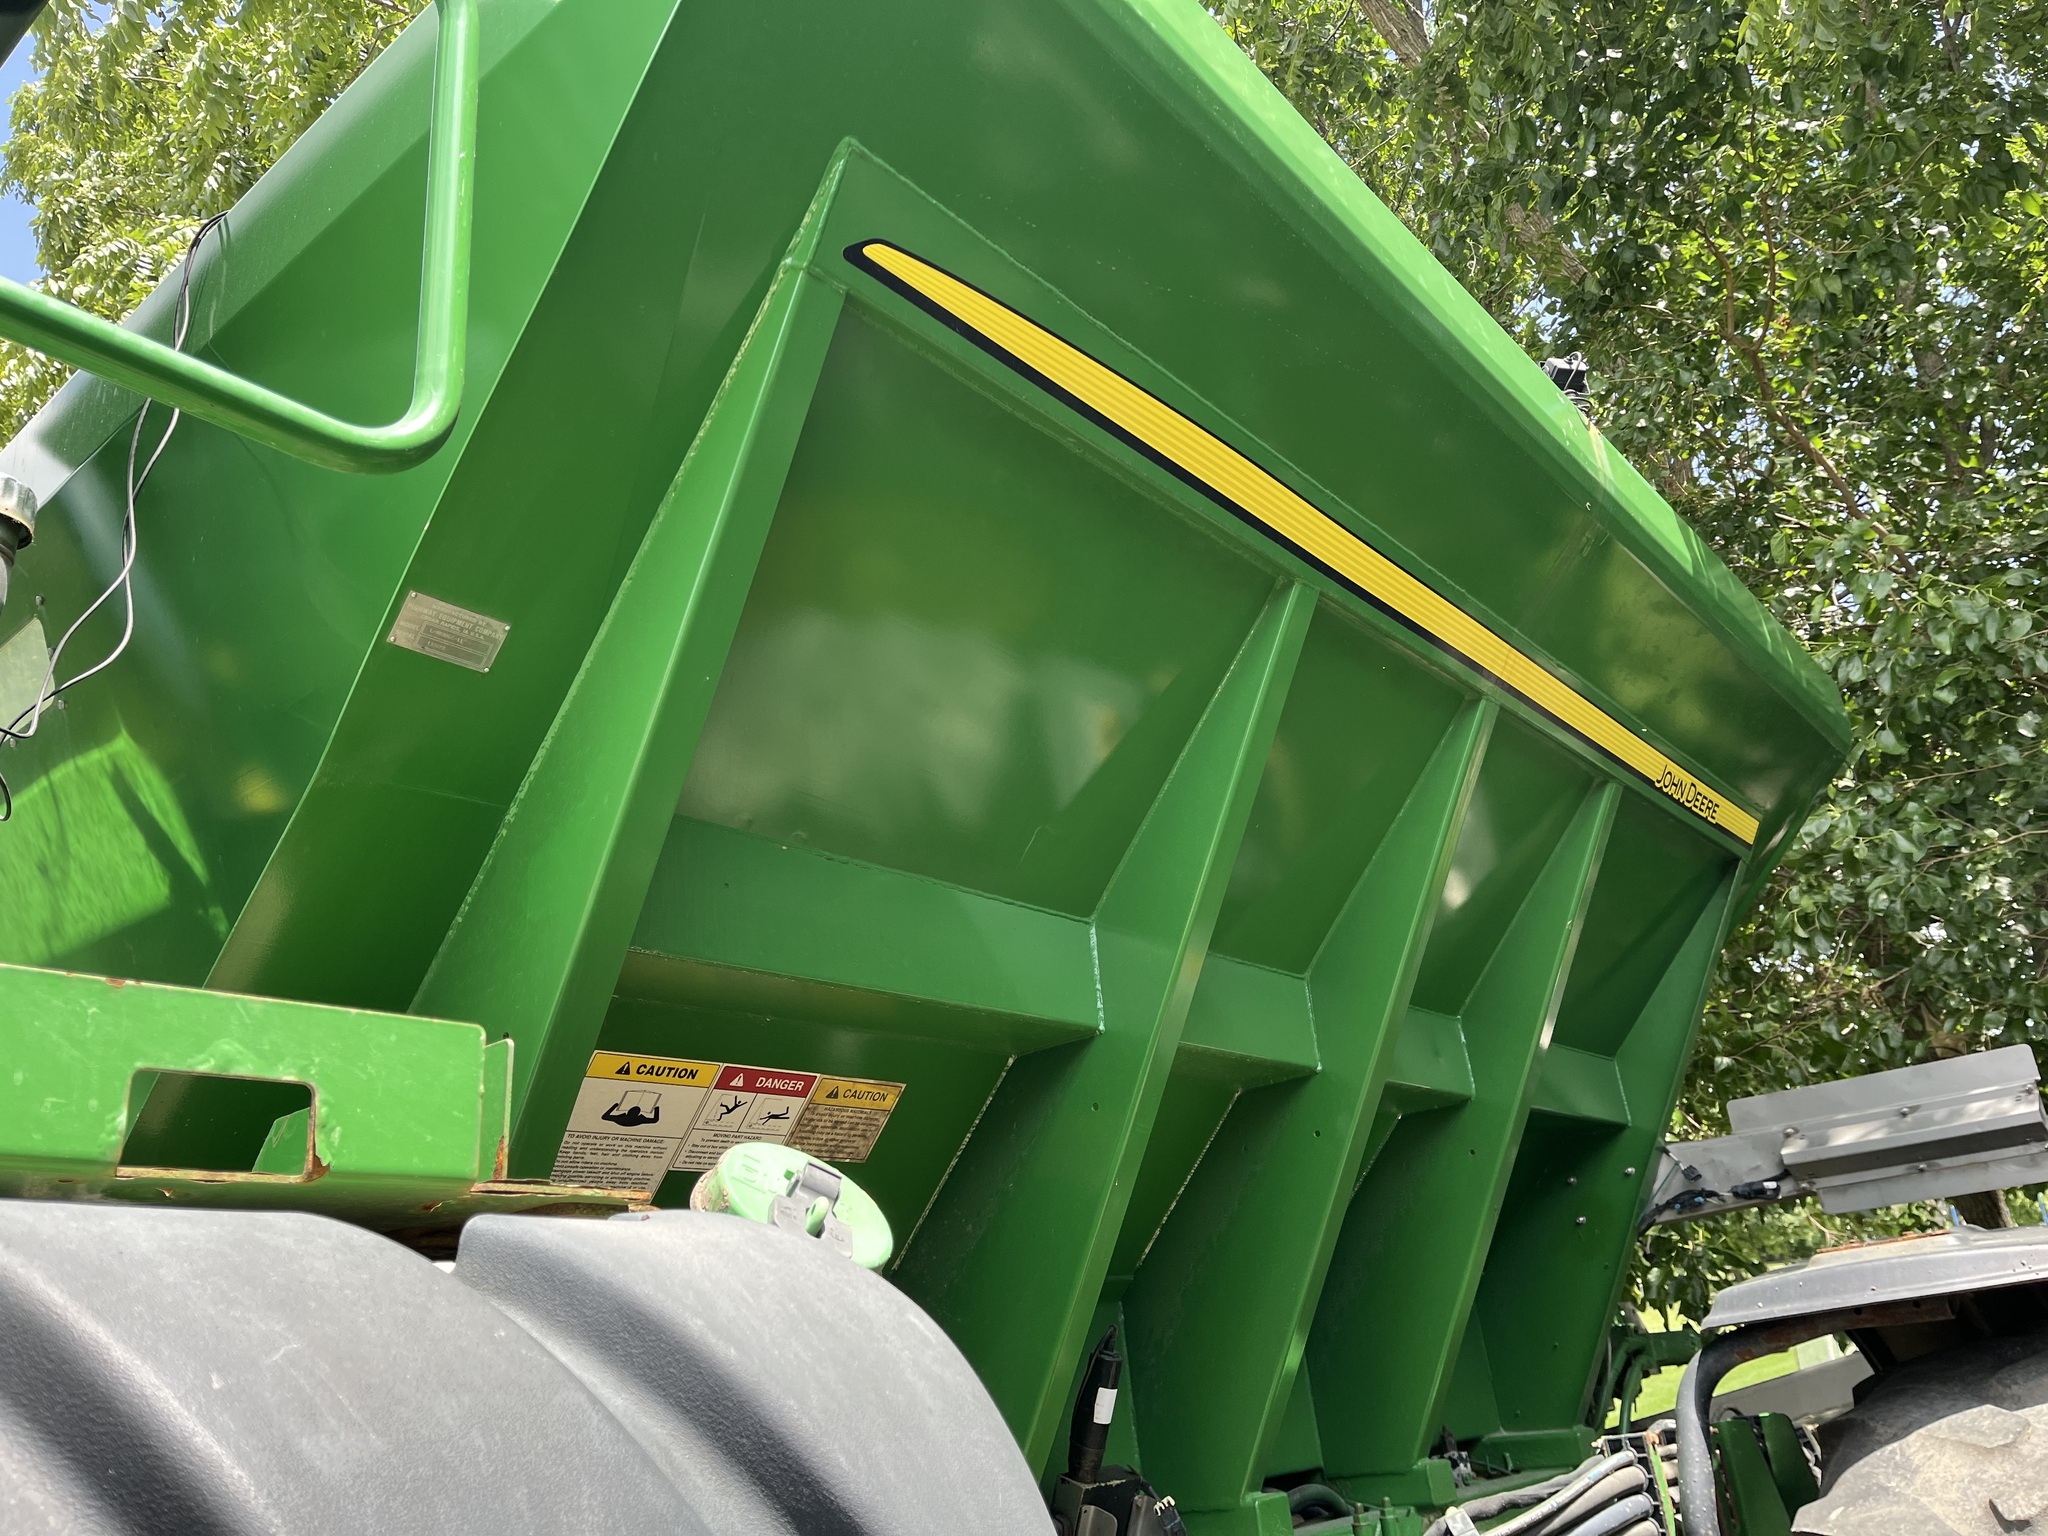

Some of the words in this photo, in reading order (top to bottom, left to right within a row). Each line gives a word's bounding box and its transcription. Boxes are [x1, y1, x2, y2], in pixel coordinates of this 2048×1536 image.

[439, 613, 472, 630] EQUIPMENT
[474, 626, 503, 640] COMPANY
[1656, 764, 1687, 798] JOHN
[1686, 782, 1720, 820] DEERE
[635, 1063, 699, 1081] CAUTION
[755, 1076, 805, 1092] DANGER
[842, 1087, 889, 1103] CAUTION
